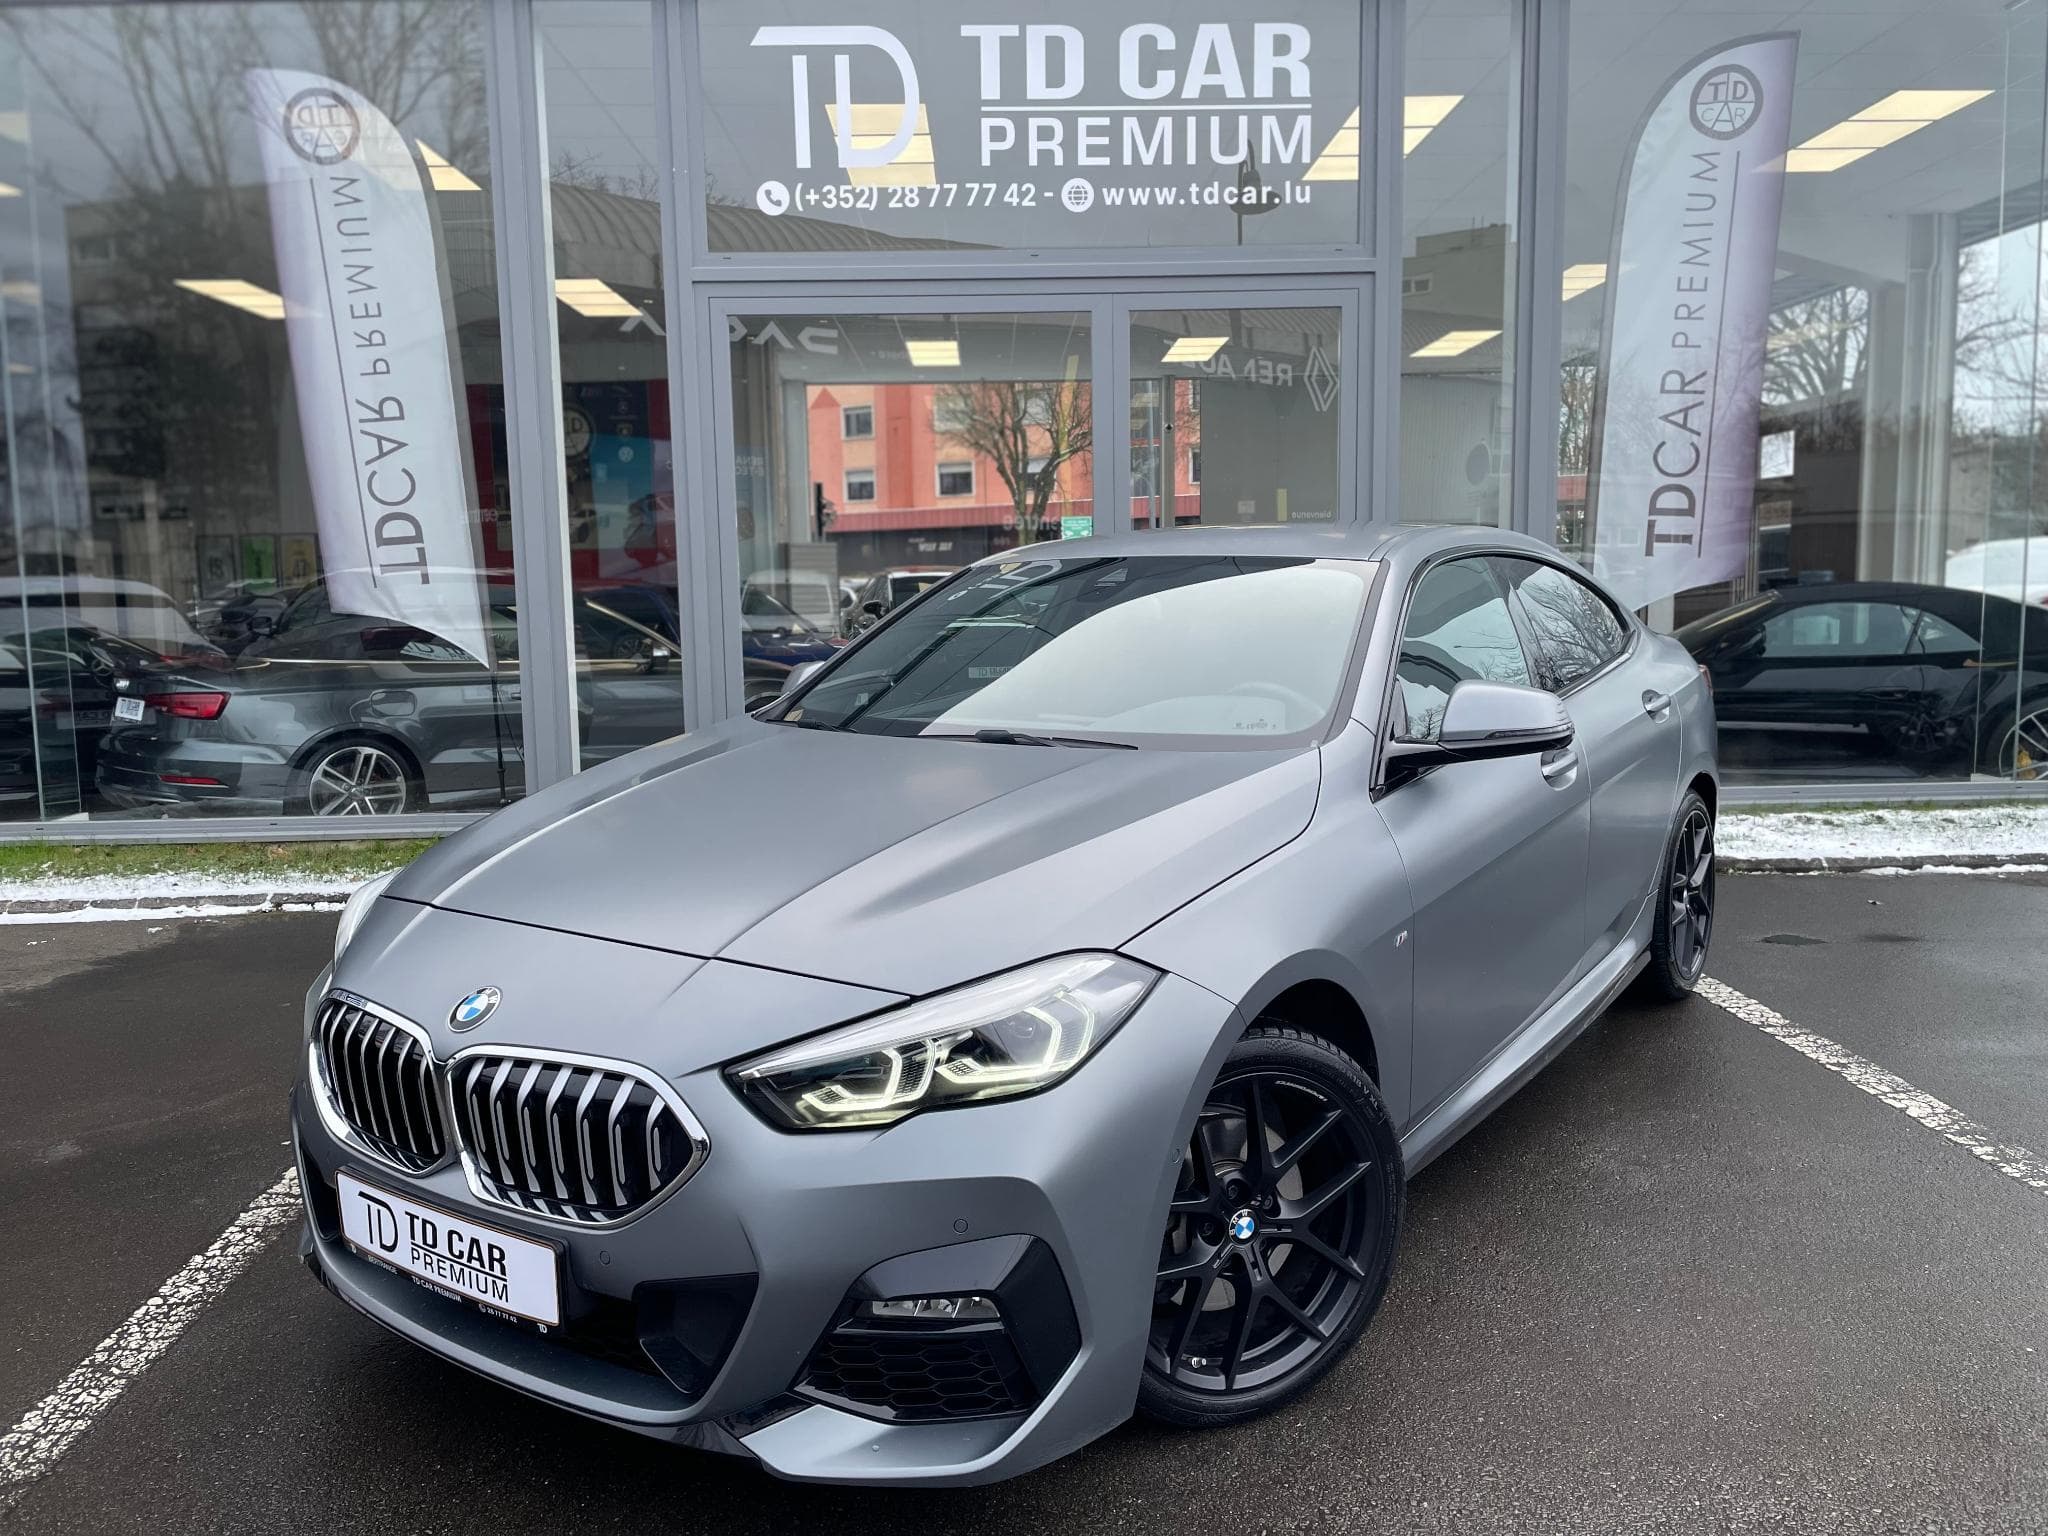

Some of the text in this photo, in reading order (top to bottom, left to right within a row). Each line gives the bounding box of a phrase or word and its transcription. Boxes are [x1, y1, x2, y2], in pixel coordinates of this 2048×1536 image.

[961, 23, 1311, 100] TD CAR
[749, 25, 919, 168] TD
[981, 115, 1311, 166] PREMIUM
[795, 182, 878, 211] (+352)
[888, 183, 920, 208] 28
[927, 183, 958, 208] 77
[964, 183, 997, 207] 77
[1003, 183, 1037, 206] 42
[1102, 181, 1311, 206] www.tdcar.lu
[1671, 151, 1720, 349] PREMIUM
[358, 1191, 398, 1253] TD
[405, 1211, 507, 1277] TD CAR
[411, 1246, 509, 1303] PREMIUM
